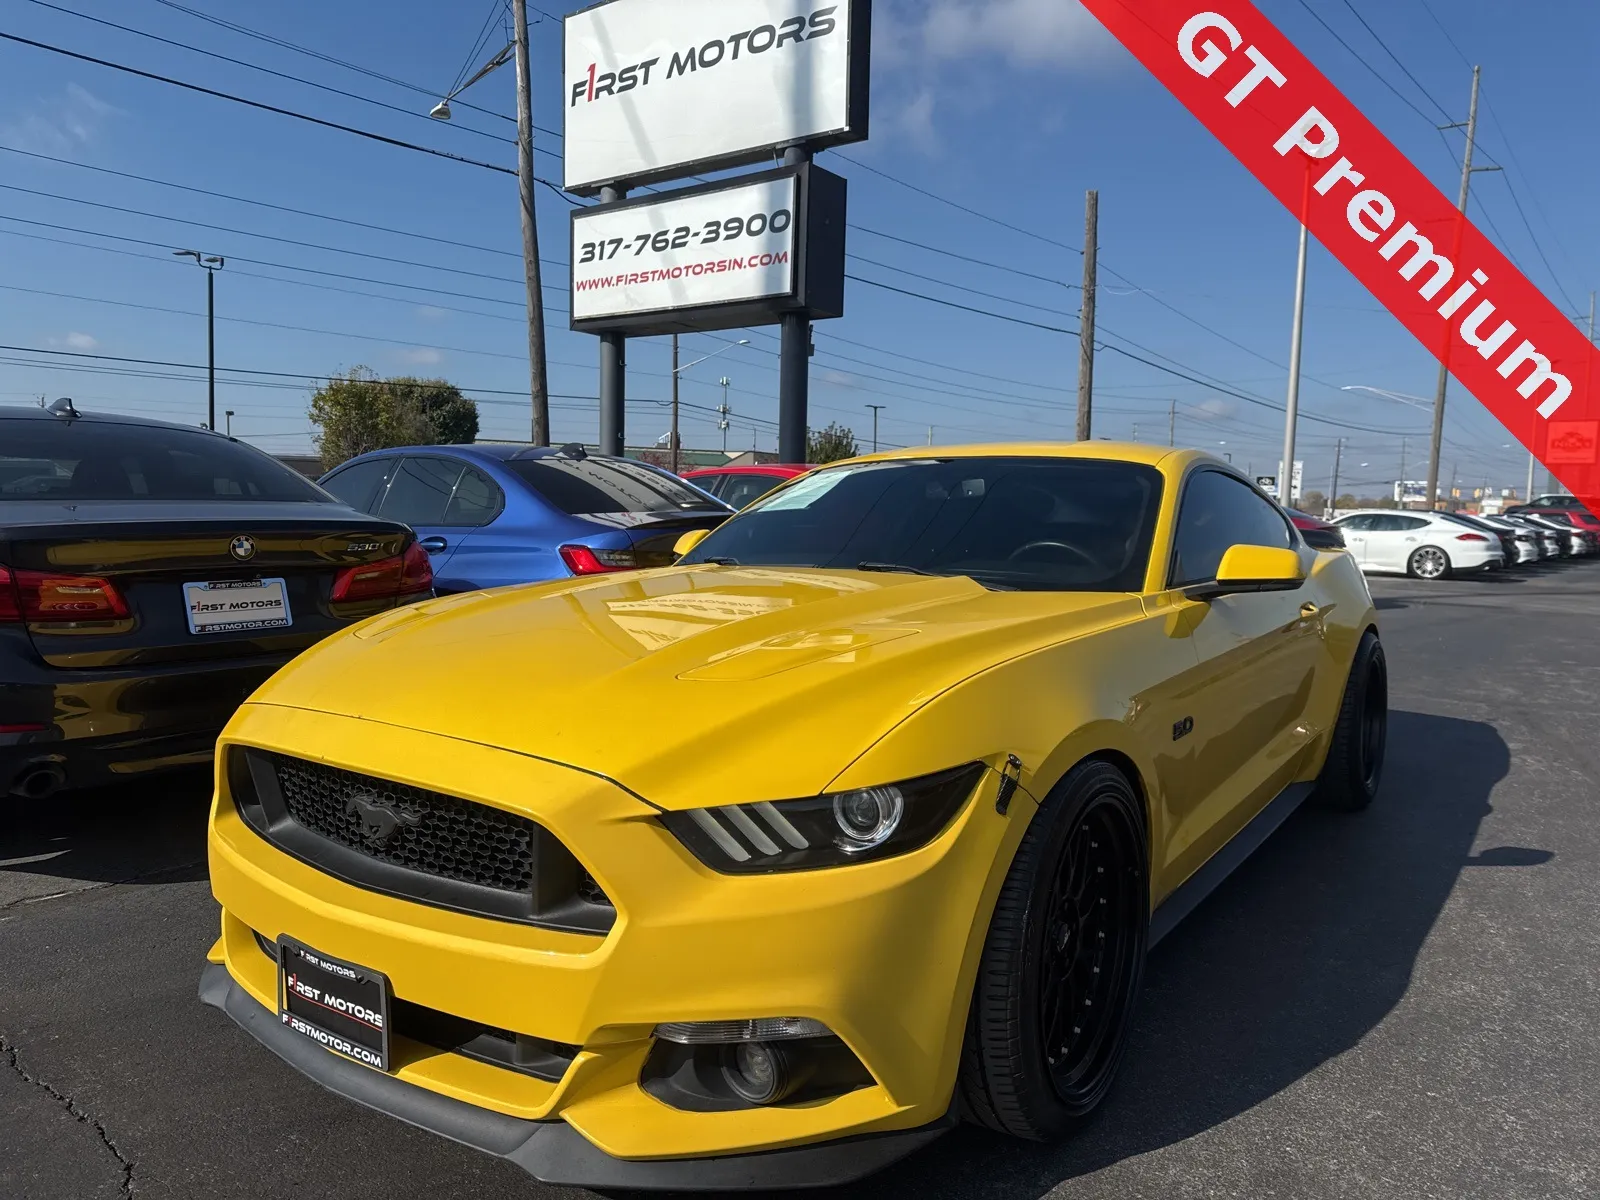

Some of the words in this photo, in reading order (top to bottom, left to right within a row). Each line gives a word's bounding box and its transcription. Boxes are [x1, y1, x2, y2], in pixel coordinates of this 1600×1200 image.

[666, 5, 838, 80] MOTORS
[579, 209, 791, 264] 317-762-3900
[576, 251, 788, 292] WWW.FIRSTMOTORSIN.COM
[229, 599, 282, 610] MOTORS
[320, 960, 356, 978] MOTORS
[324, 993, 383, 1028] MOTORS
